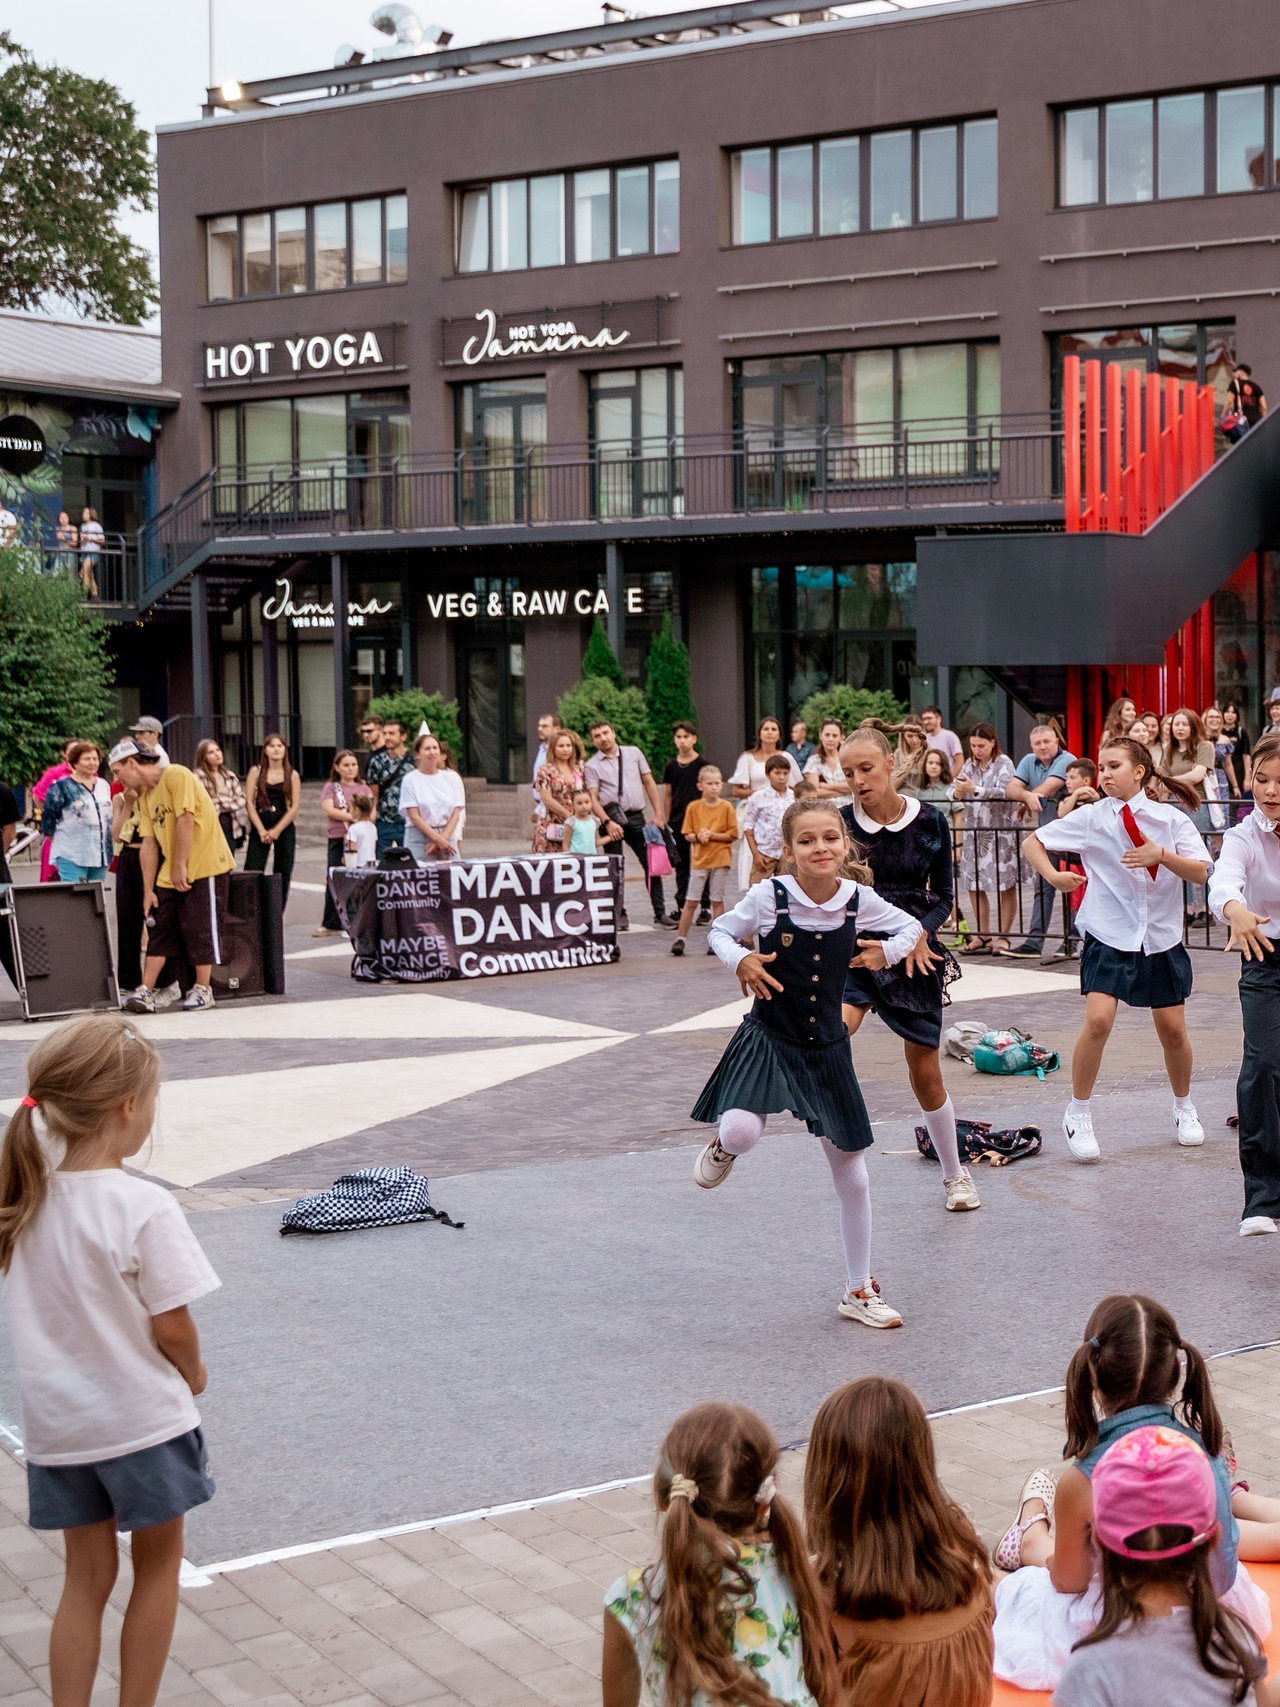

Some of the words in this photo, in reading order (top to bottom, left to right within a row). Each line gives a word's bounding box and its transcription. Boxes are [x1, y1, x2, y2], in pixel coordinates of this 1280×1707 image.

[509, 324, 537, 340] HOT
[539, 321, 577, 338] YOGA
[206, 342, 275, 379] HOT
[285, 331, 384, 371] YOGA
[427, 593, 477, 618] VEG
[487, 592, 502, 616] &
[512, 590, 567, 616] RAW
[574, 588, 643, 614] CAE
[292, 616, 310, 628] VEG
[311, 616, 318, 627] &
[450, 856, 613, 900] MAYBE
[376, 880, 440, 898] DANCE
[377, 897, 441, 911] Community
[452, 898, 615, 945] DANCE
[380, 935, 447, 954] MAYBE
[381, 952, 450, 968] DANCE
[460, 940, 614, 977] Community
